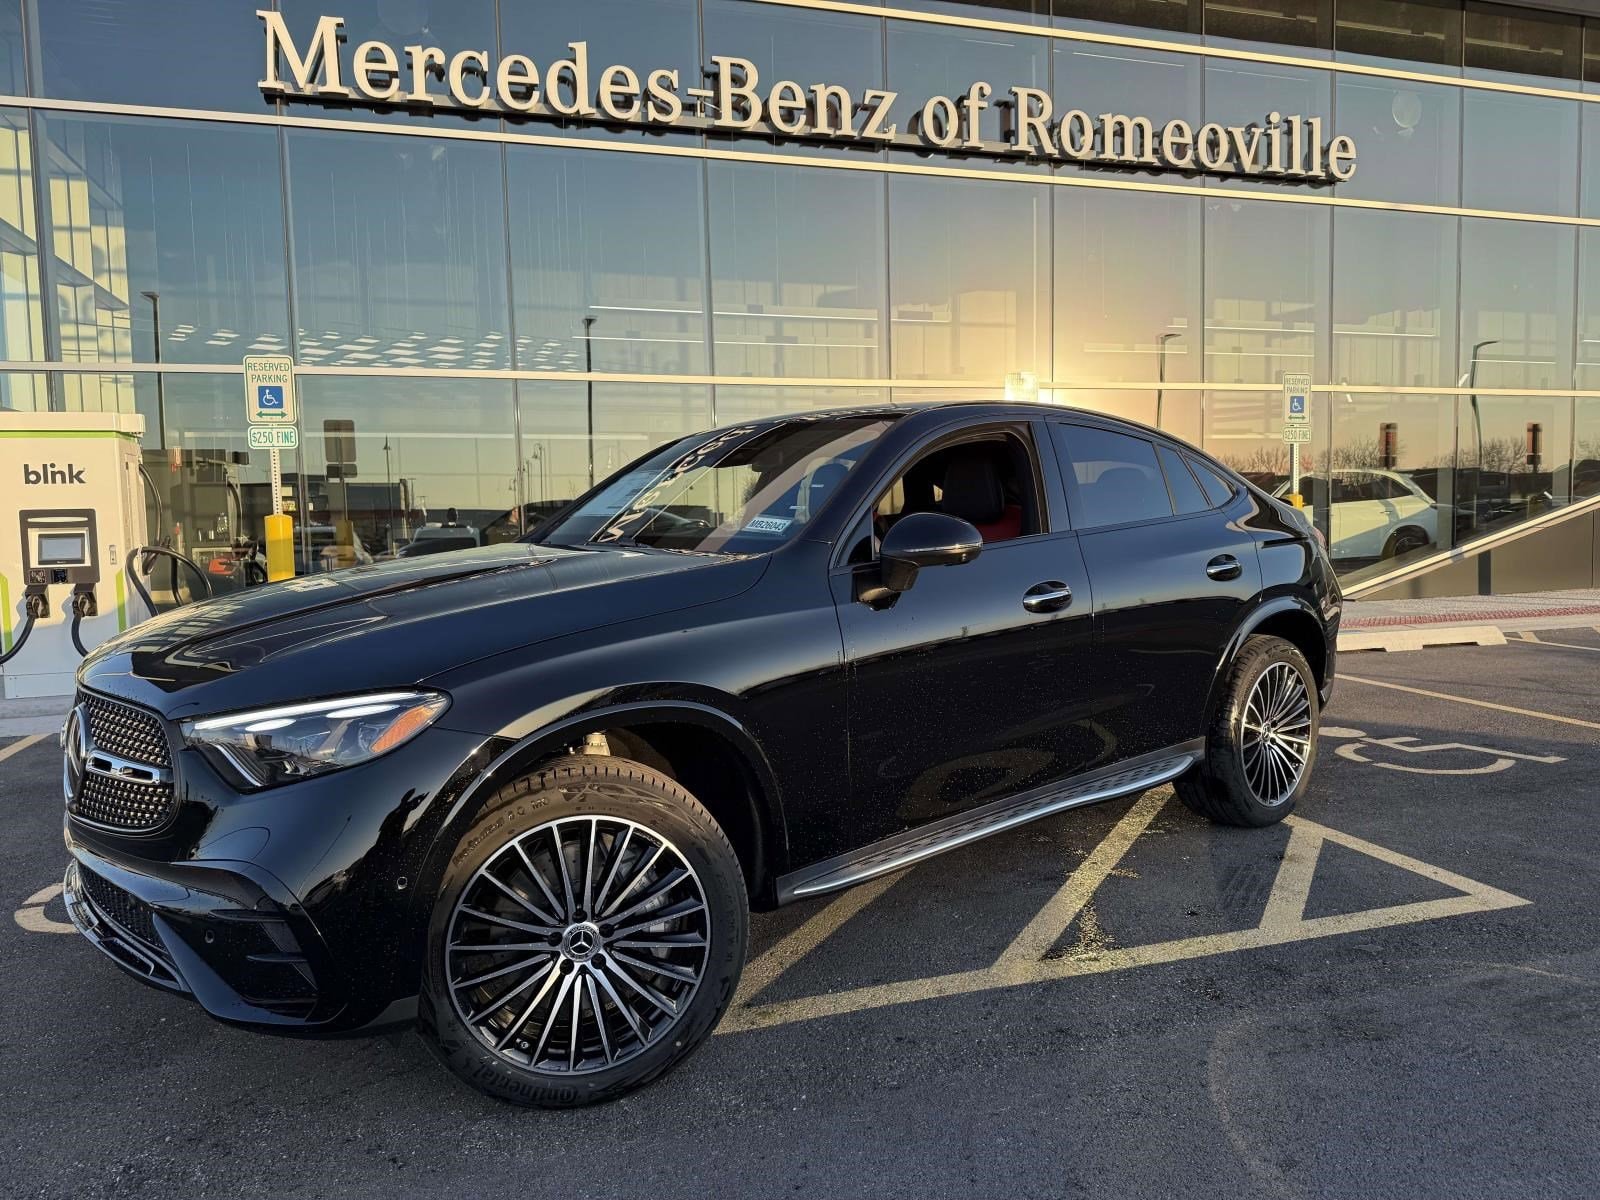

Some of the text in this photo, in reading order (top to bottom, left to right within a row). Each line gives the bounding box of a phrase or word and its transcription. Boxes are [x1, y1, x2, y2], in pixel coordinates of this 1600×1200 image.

[256, 10, 1357, 181] Mercedes-Benz of Romeoville
[247, 362, 290, 372] RESERVED
[251, 374, 288, 383] PARKING
[1286, 378, 1309, 386] RESERVED
[1286, 386, 1308, 394] PARKING
[252, 431, 295, 444] $250 FINE
[1285, 430, 1297, 440] $250
[23, 462, 87, 485] blink
